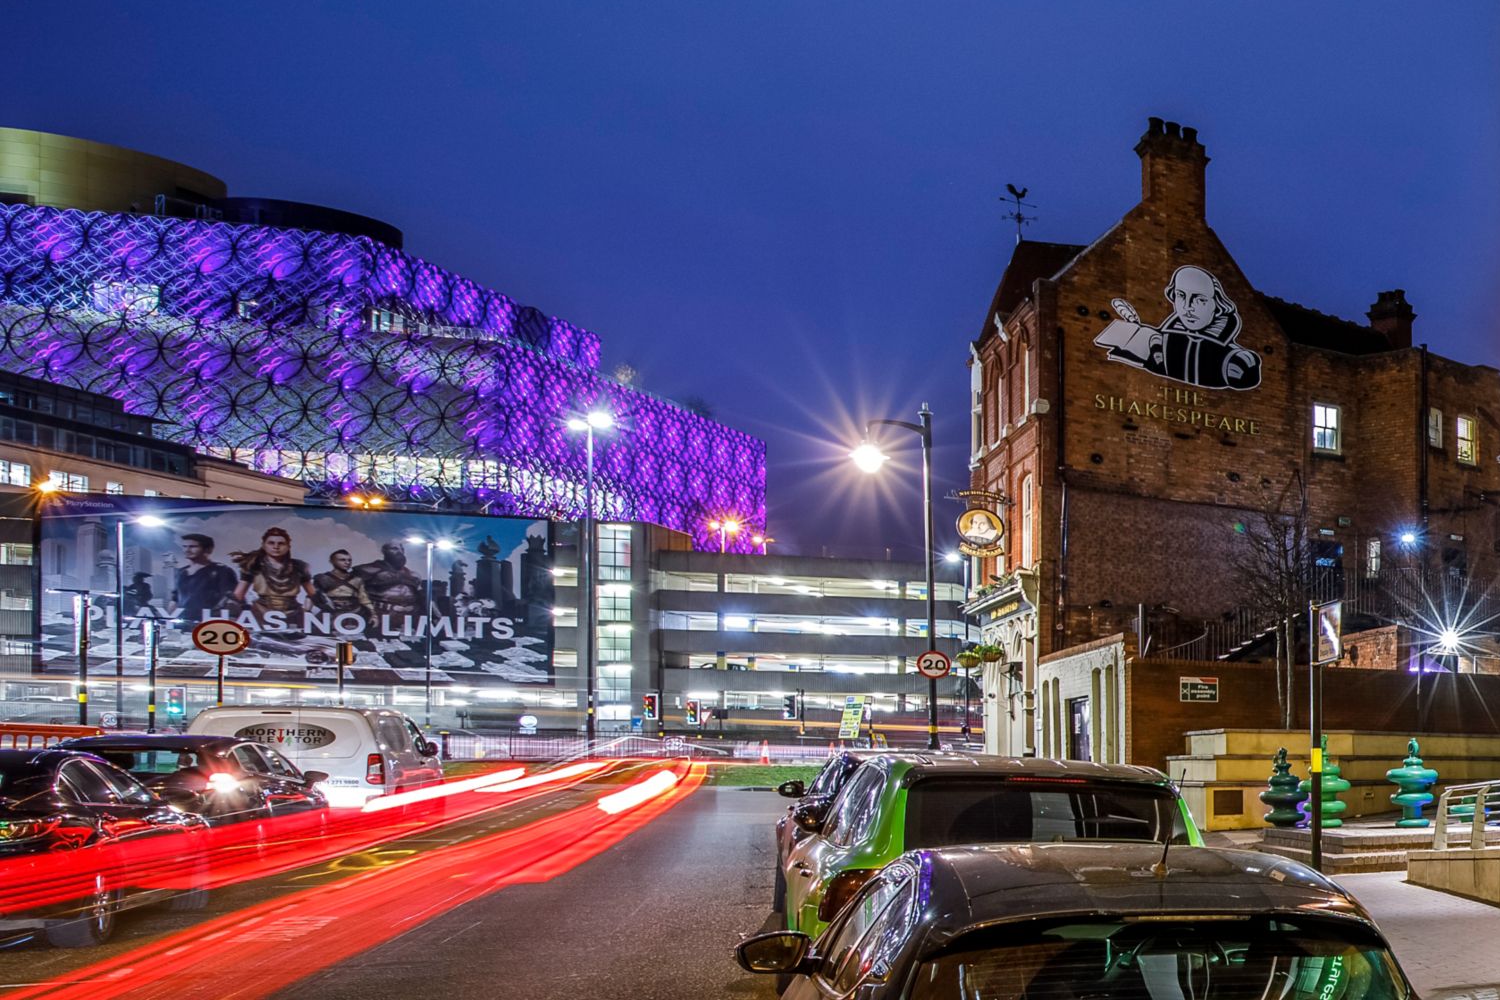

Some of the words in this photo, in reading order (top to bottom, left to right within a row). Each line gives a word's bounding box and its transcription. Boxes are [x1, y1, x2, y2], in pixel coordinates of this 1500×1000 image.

[1160, 386, 1205, 407] THE
[1094, 393, 1263, 435] SHAKESPEARE
[66, 500, 114, 509] PlayStation
[88, 605, 185, 629] PLAY
[203, 608, 288, 632] HAS
[303, 612, 366, 636] NO
[201, 630, 241, 645] 20
[923, 658, 946, 670] 20
[244, 728, 327, 738] NORTHERN
